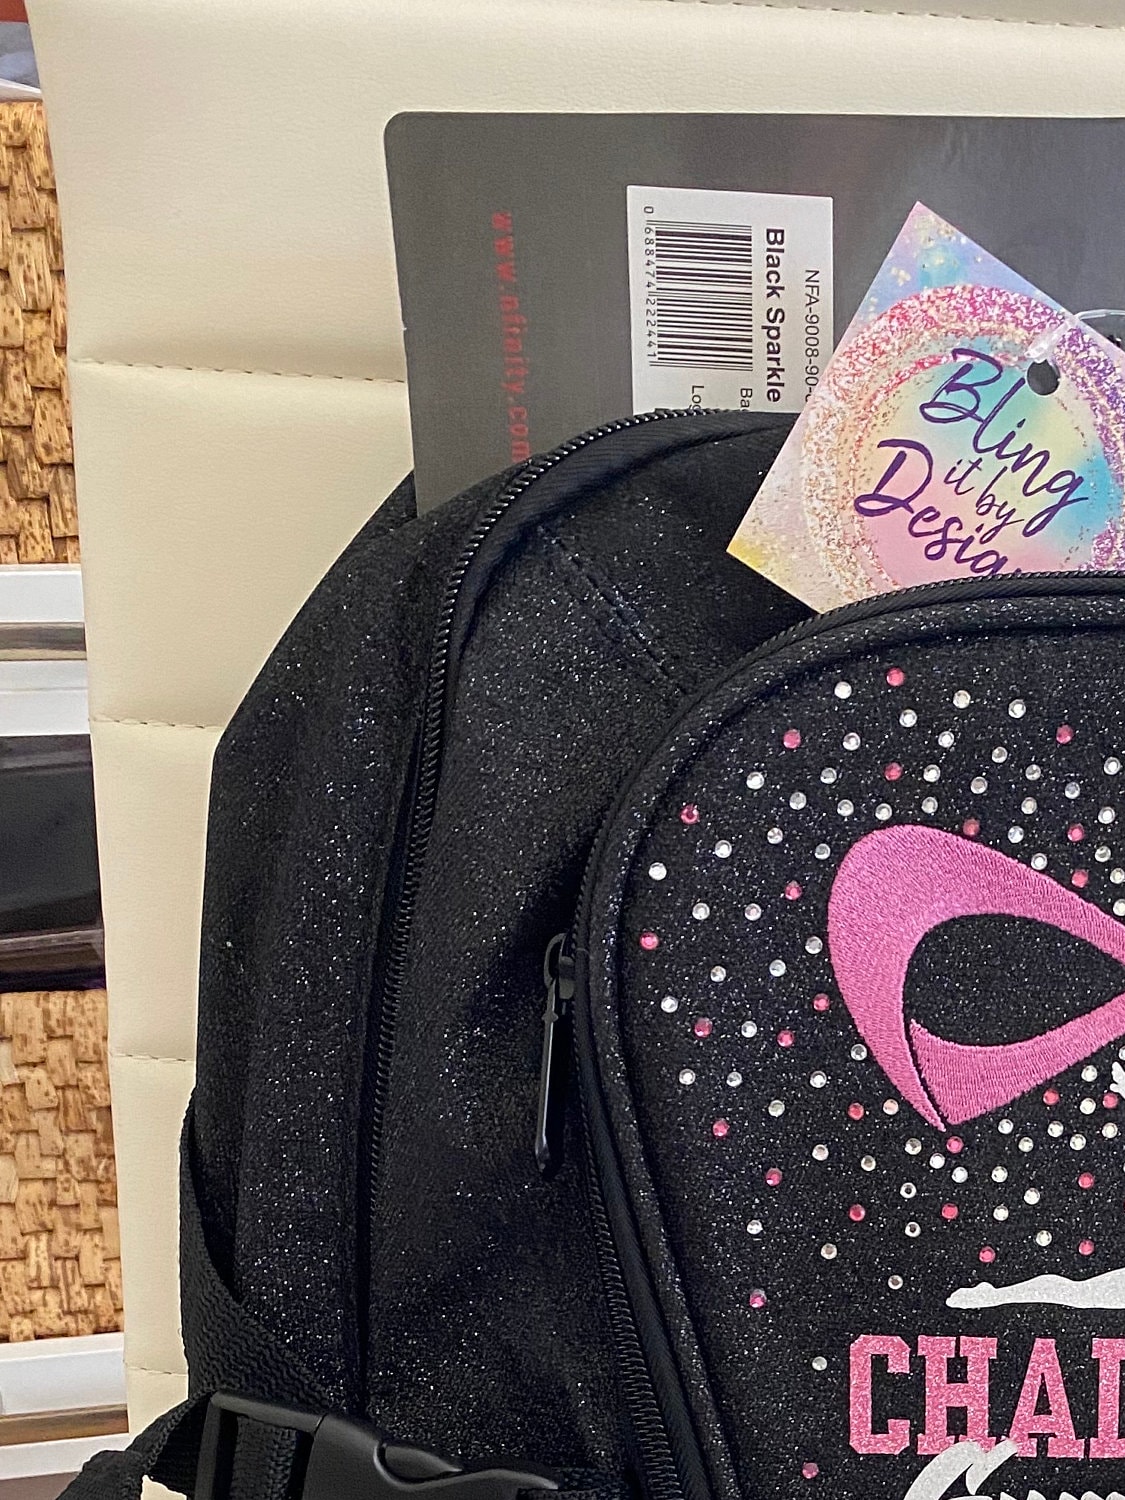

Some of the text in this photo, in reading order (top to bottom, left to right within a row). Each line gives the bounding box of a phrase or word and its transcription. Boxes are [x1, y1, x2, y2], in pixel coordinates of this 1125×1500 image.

[643, 206, 657, 359] 0 688474 222441
[761, 228, 785, 403] Black Sparkle
[804, 269, 820, 402] NFA-9008-90-
[740, 388, 753, 411] Ba
[920, 348, 1089, 538] Bling
[854, 438, 1022, 574] Desig
[943, 458, 1024, 545] it by
